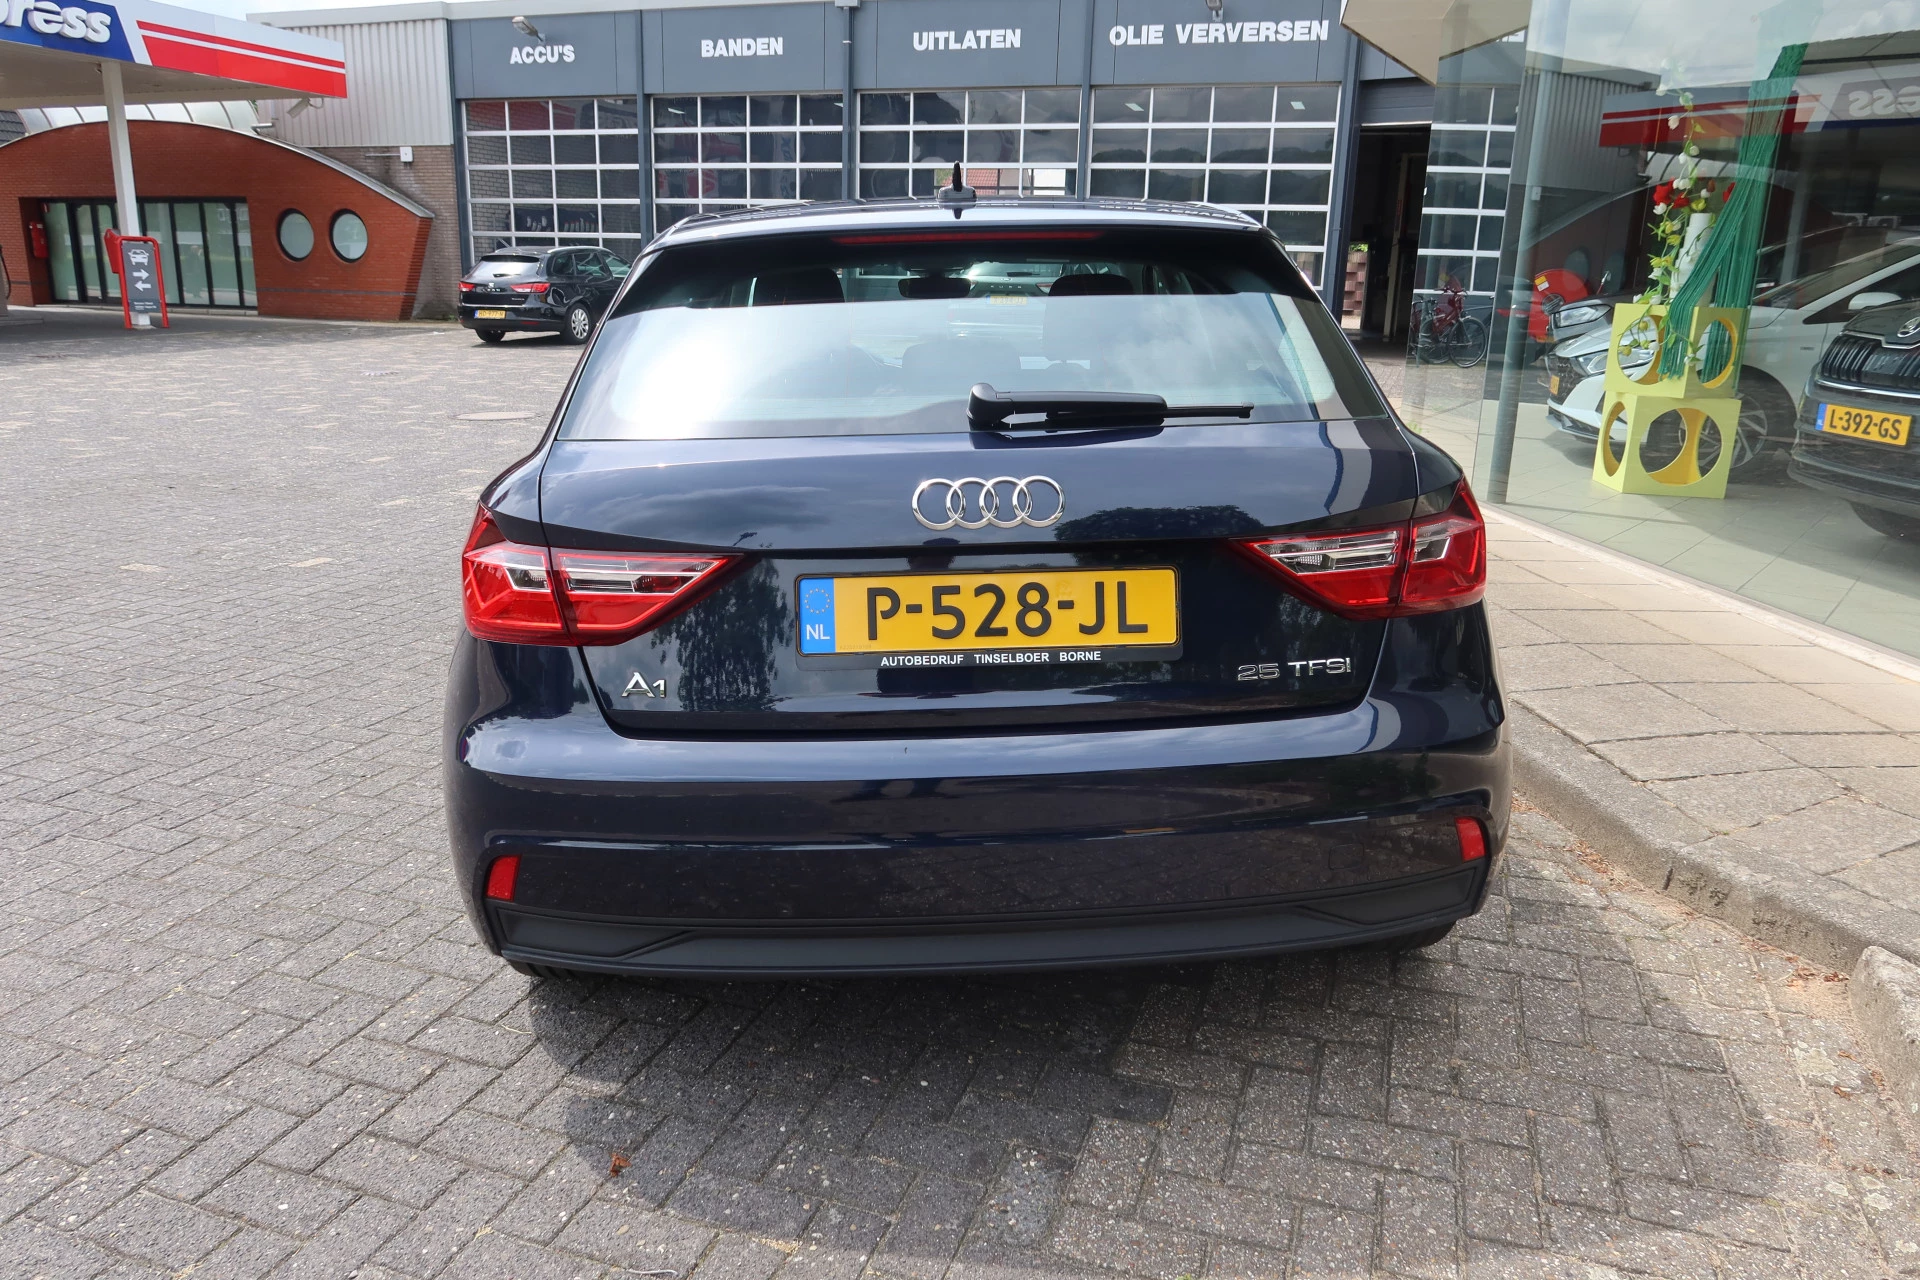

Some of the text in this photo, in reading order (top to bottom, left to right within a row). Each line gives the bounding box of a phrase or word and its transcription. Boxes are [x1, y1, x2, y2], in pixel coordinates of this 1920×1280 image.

[912, 28, 1021, 51] UITLATEN
[1109, 20, 1329, 46] OLIE VERVERSEN
[510, 45, 575, 64] ACCU'S
[700, 37, 784, 58] BANDEN
[1829, 409, 1902, 440] L-392-GS
[867, 581, 1148, 640] P-528-JL
[805, 623, 831, 640] NL
[880, 650, 1102, 667] AUTOBEDRIJF TINSELBOER BORNE
[1238, 657, 1351, 681] 25 TFSI
[621, 671, 666, 698] A1
